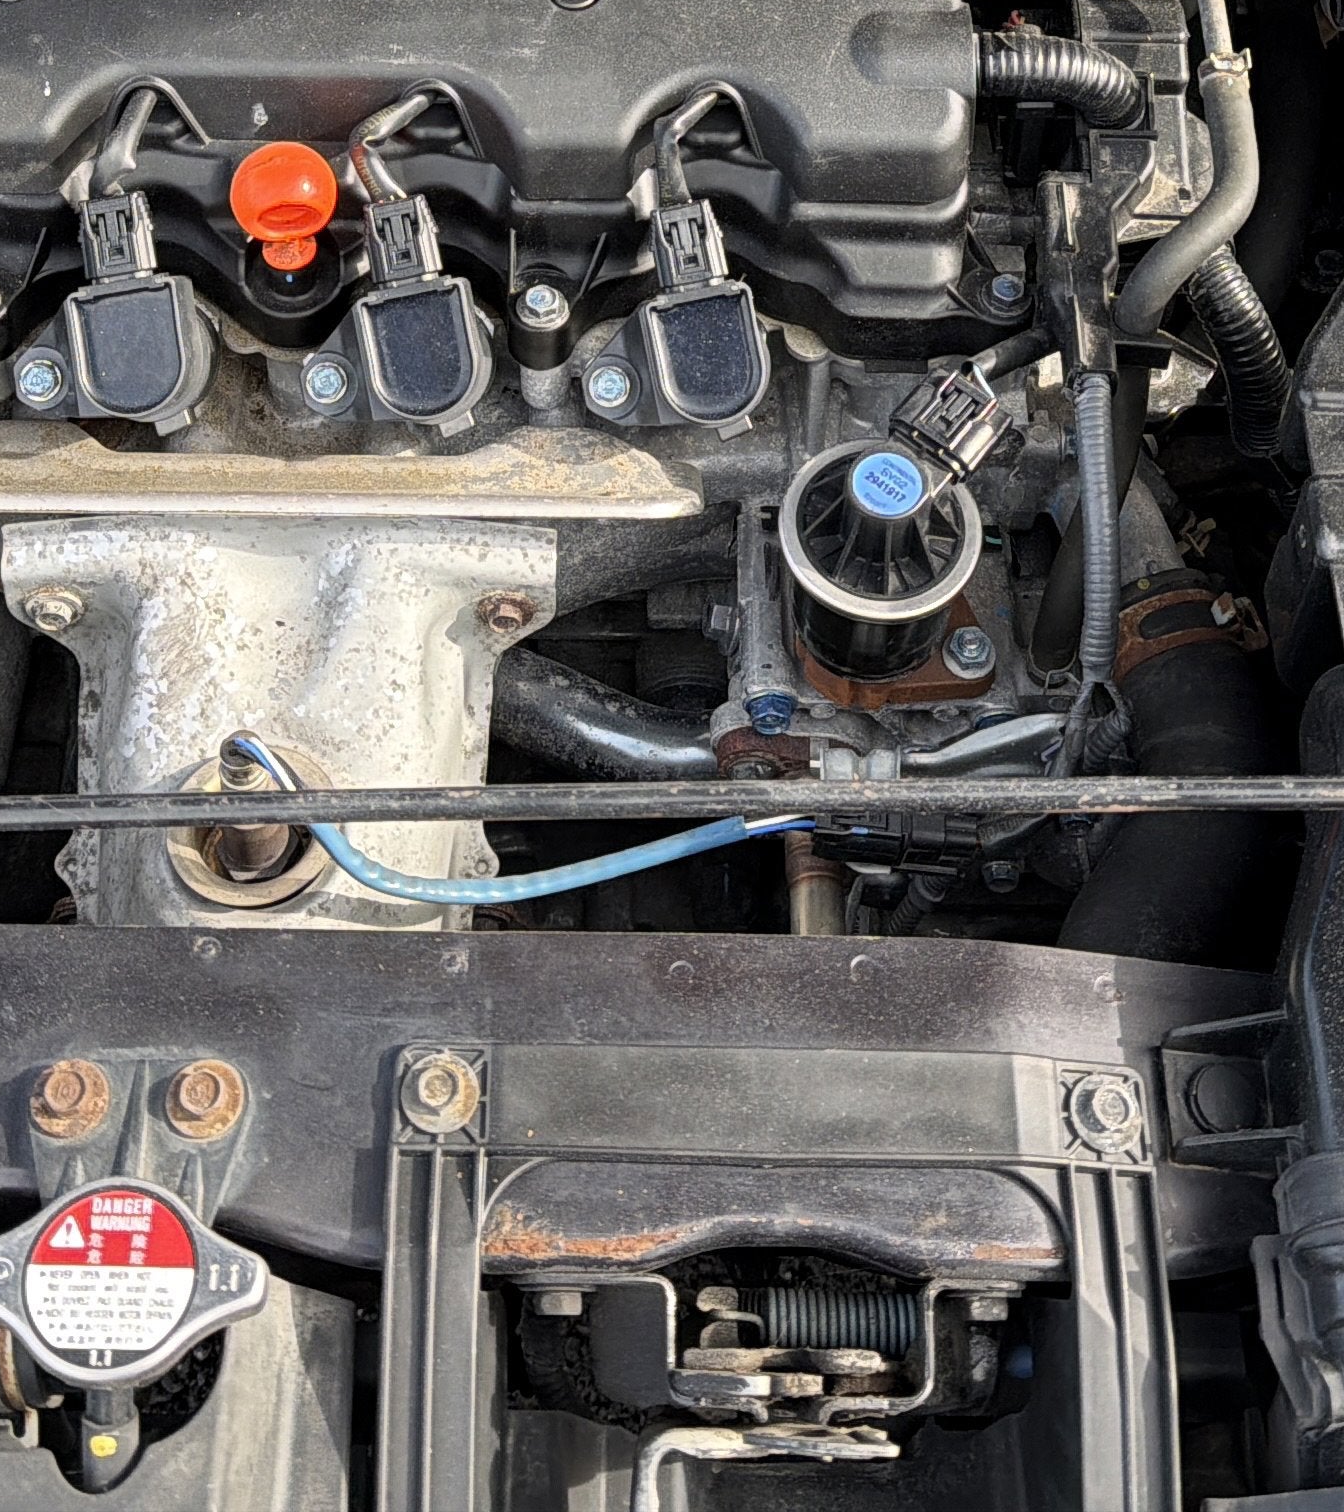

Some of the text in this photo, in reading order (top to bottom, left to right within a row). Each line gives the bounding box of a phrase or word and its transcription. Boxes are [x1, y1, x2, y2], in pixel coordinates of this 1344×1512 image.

[91, 1197, 153, 1215] DANGER
[90, 1215, 153, 1233] WARNING
[209, 1264, 240, 1291] 1.1
